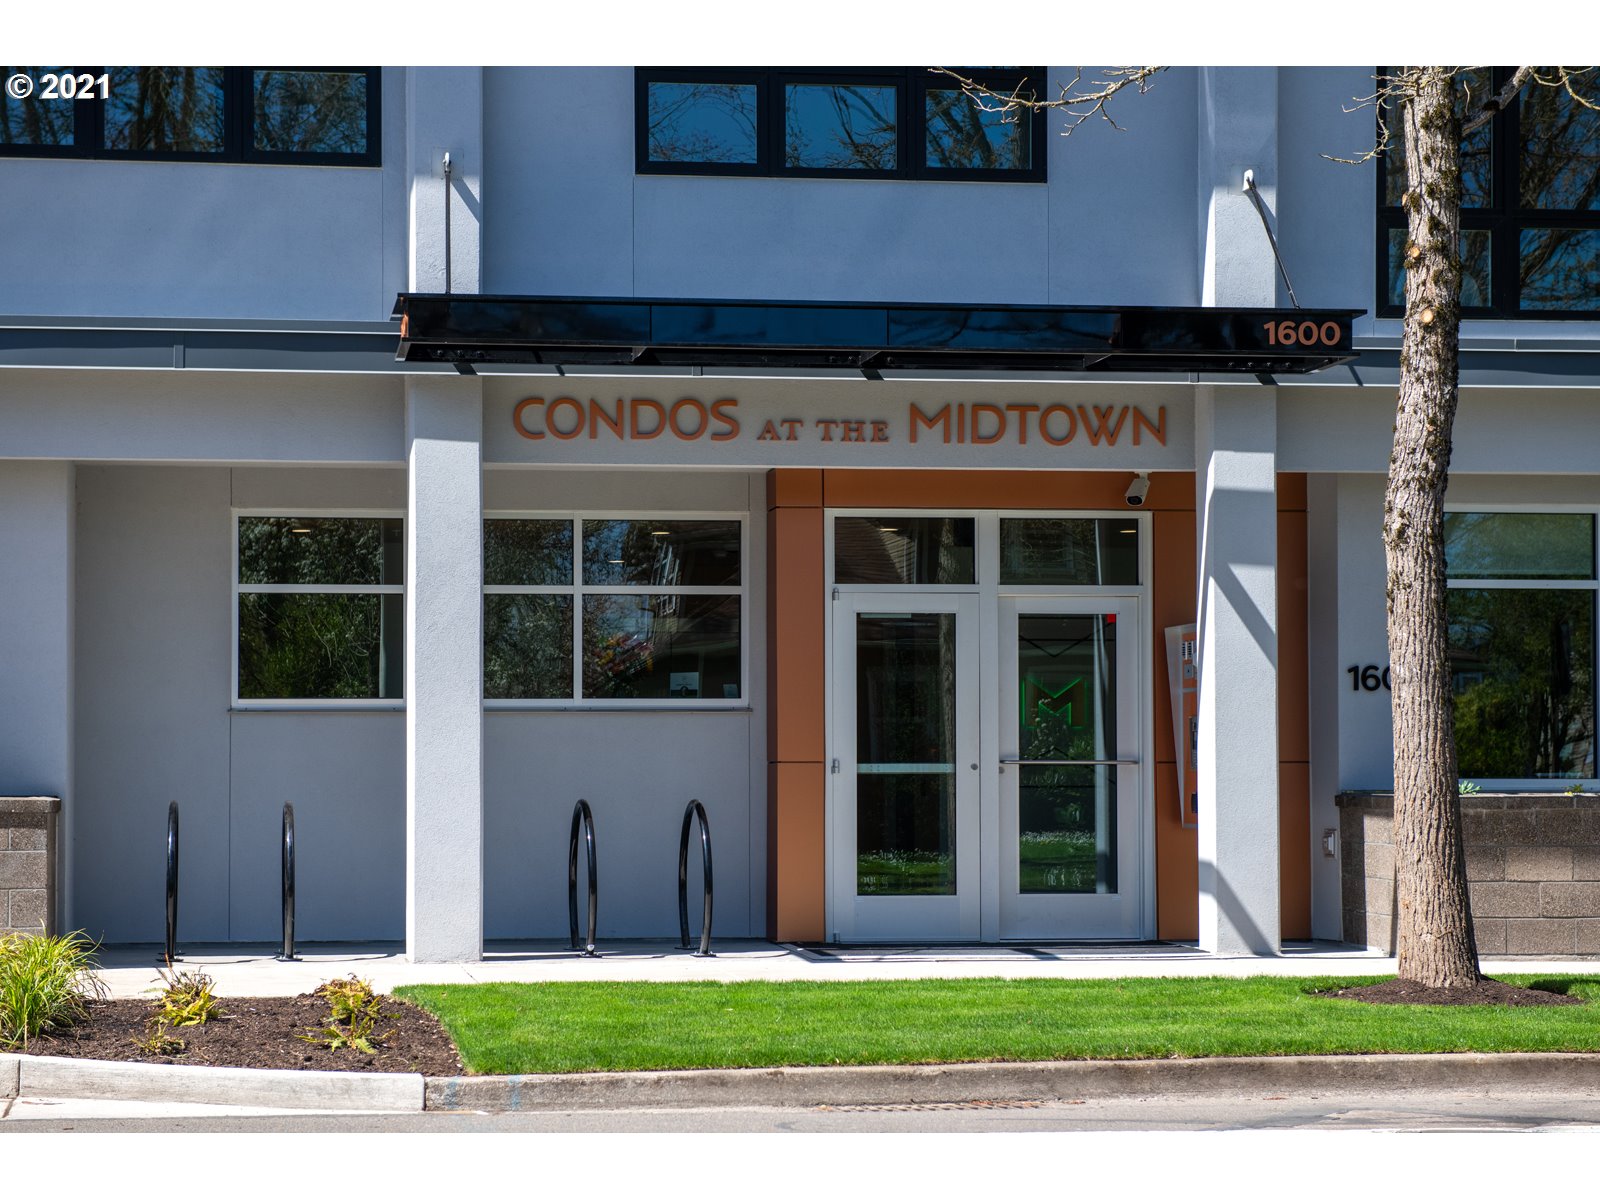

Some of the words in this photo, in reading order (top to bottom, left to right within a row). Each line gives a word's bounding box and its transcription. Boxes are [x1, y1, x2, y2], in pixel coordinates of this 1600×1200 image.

[1264, 321, 1341, 345] 1600
[513, 397, 741, 441] CONDOS
[757, 419, 803, 441] AT
[816, 420, 889, 442] THE
[909, 402, 1166, 447] MIDTOWN
